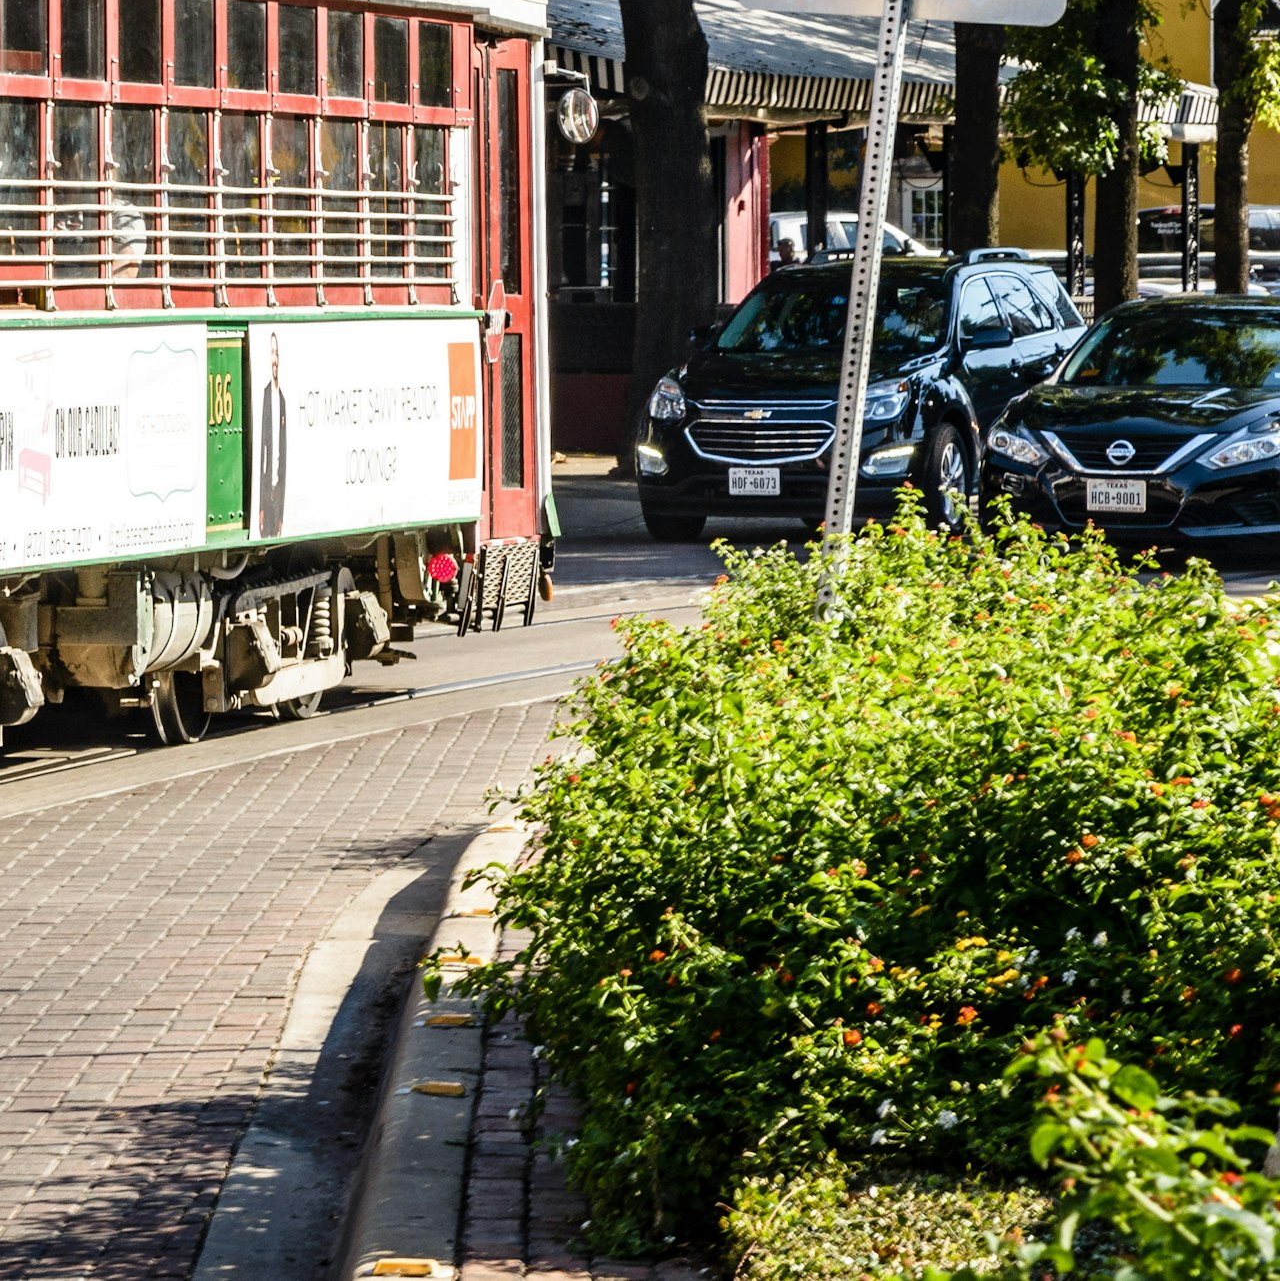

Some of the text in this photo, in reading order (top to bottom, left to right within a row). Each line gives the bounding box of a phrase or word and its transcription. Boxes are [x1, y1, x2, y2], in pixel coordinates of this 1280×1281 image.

[486, 309, 506, 336] STOP
[208, 373, 232, 426] 186
[300, 390, 320, 427] HOT
[451, 395, 476, 431] STAPP
